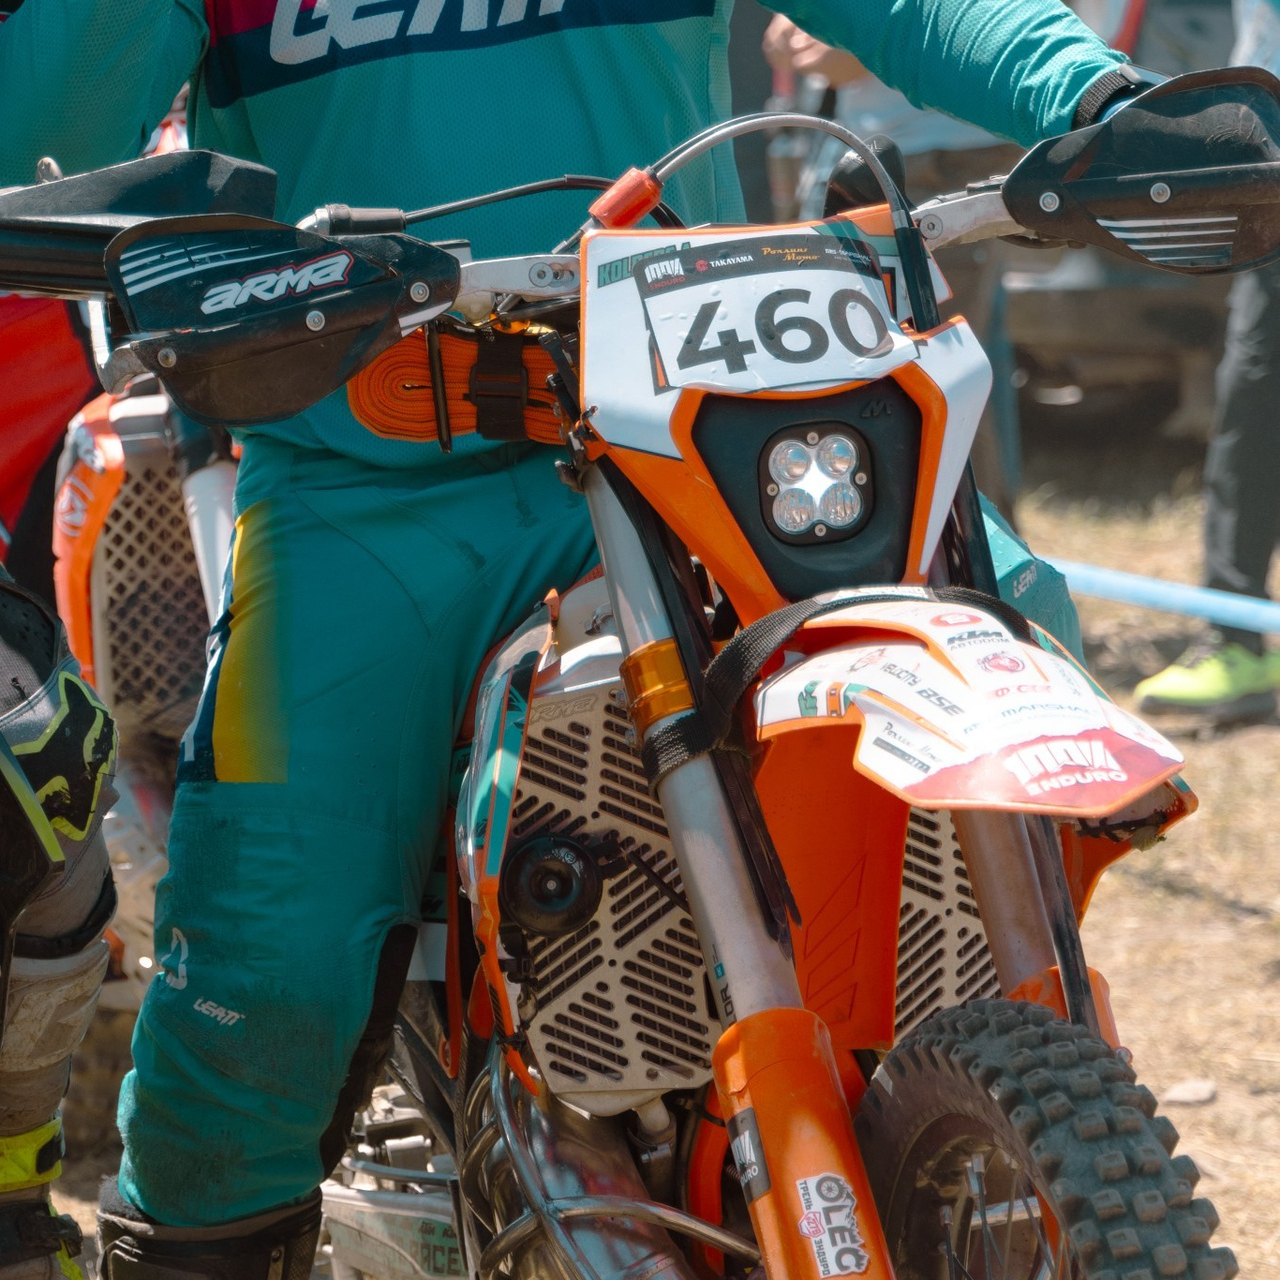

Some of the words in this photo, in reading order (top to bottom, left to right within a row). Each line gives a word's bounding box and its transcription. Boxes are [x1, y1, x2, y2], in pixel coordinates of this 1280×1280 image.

[709, 254, 754, 268] TAKAYAMA
[676, 287, 895, 375] 460
[947, 630, 1004, 647] KTM
[916, 687, 966, 717] BSE
[1024, 769, 1129, 797] ENDURO
[193, 996, 245, 1027] LEATT
[798, 1179, 813, 1211] ТРЕНЬ
[813, 1237, 831, 1276] ЭНДУРО
